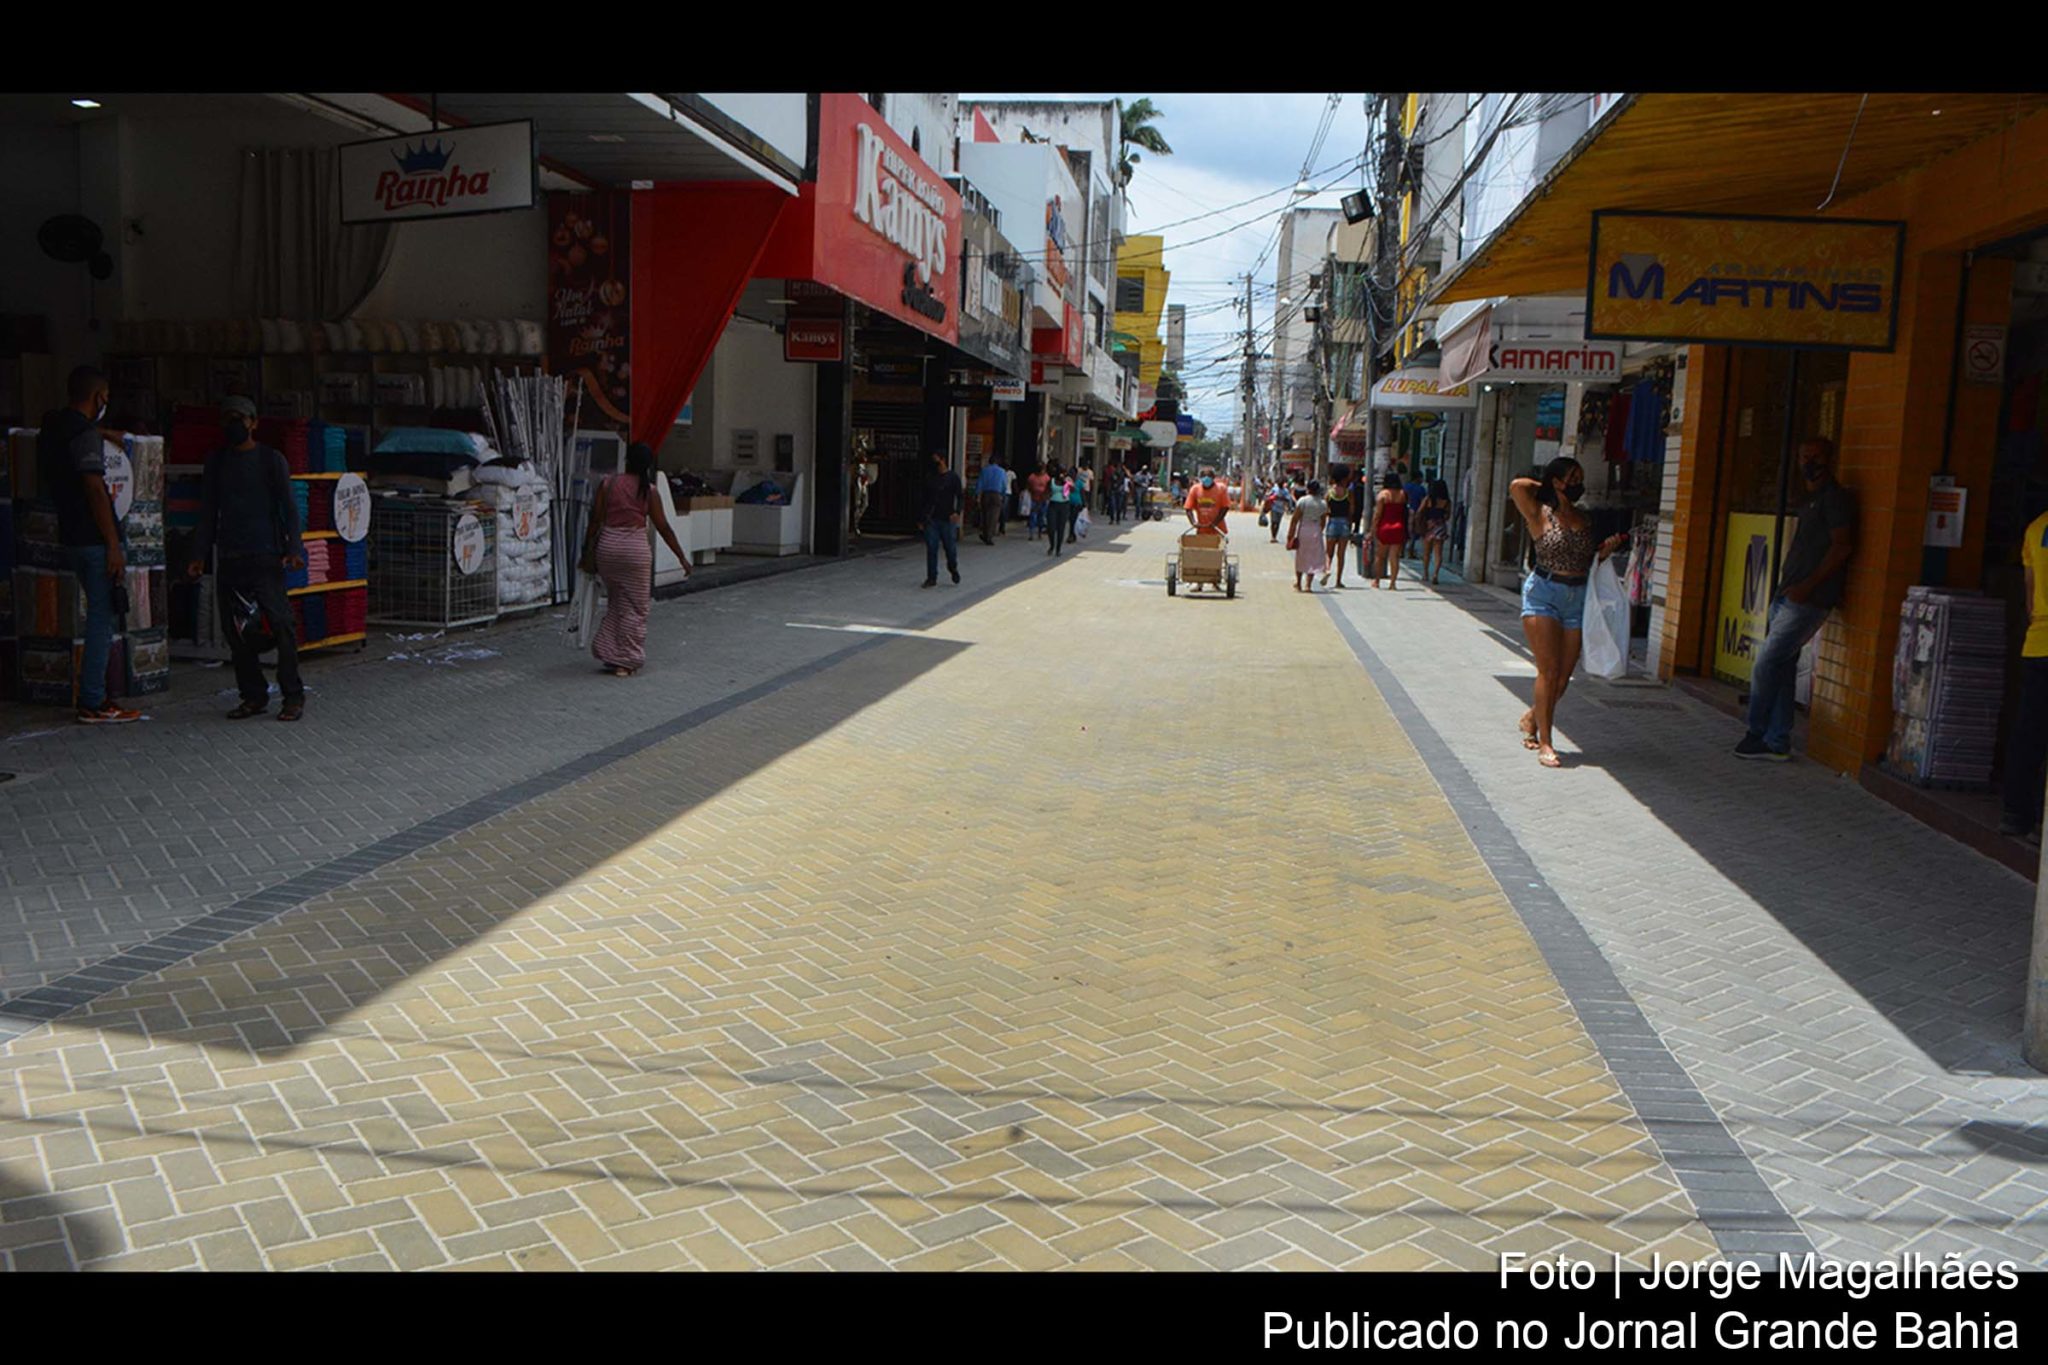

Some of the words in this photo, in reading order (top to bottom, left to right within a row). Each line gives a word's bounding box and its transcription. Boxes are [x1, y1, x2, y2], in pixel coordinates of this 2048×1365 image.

[375, 165, 490, 211] Rainha
[855, 123, 947, 284] Kamys
[1608, 260, 1884, 314] MARTINS
[569, 332, 626, 357] Rainha
